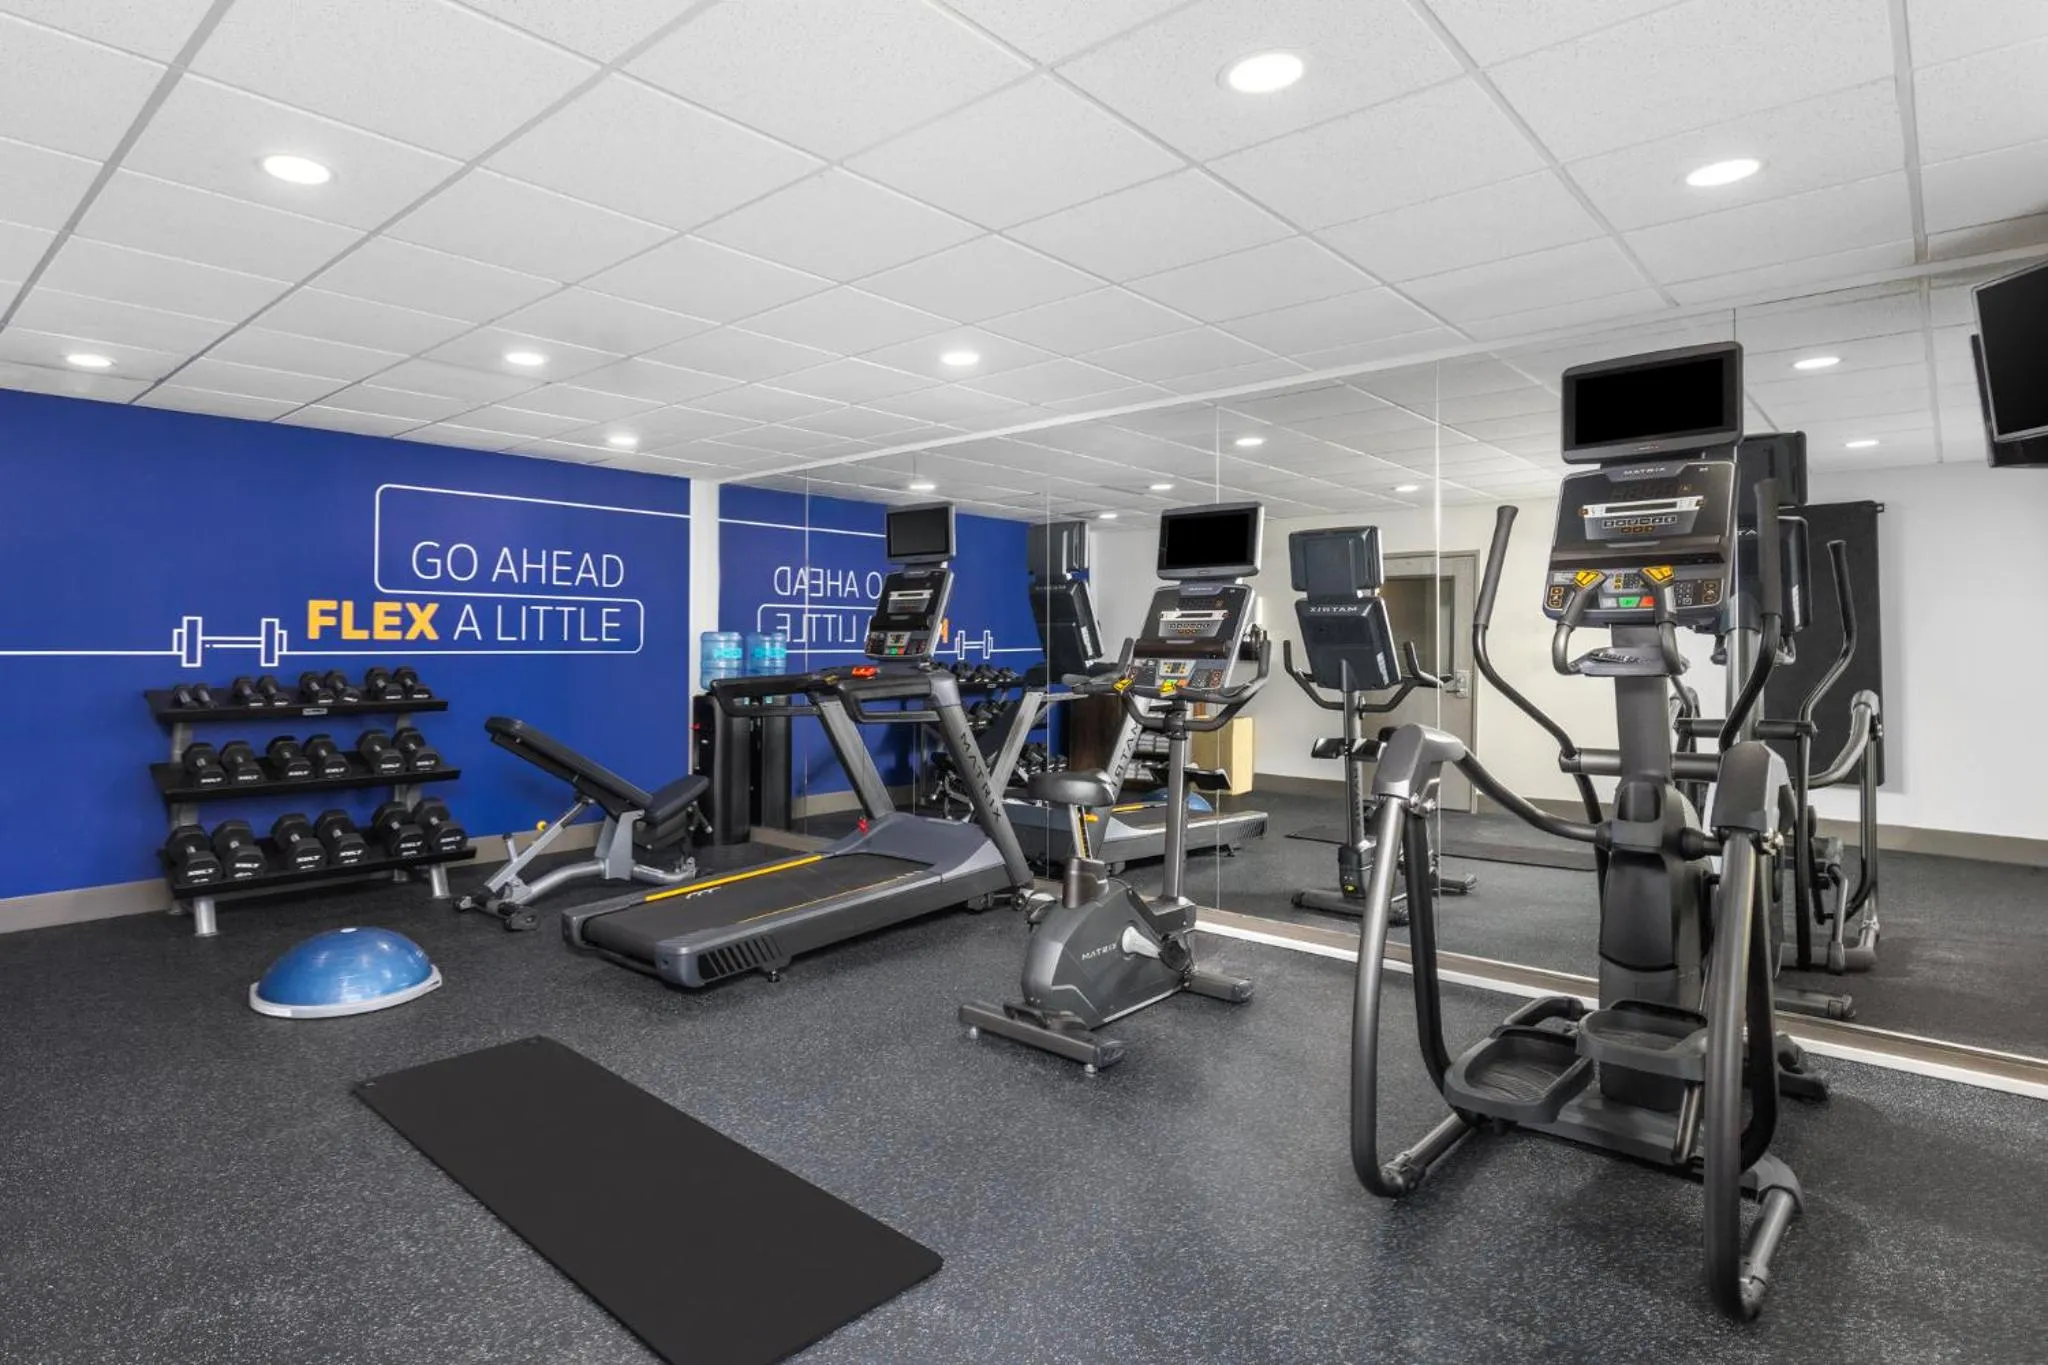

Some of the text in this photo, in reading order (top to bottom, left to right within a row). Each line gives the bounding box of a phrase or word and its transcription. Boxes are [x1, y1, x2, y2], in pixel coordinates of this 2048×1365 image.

[412, 540, 625, 588] GO AHEAD
[307, 599, 622, 642] FLEX A LITTLE
[960, 731, 1002, 824] MATRIX
[1081, 942, 1118, 961] MATRIX
